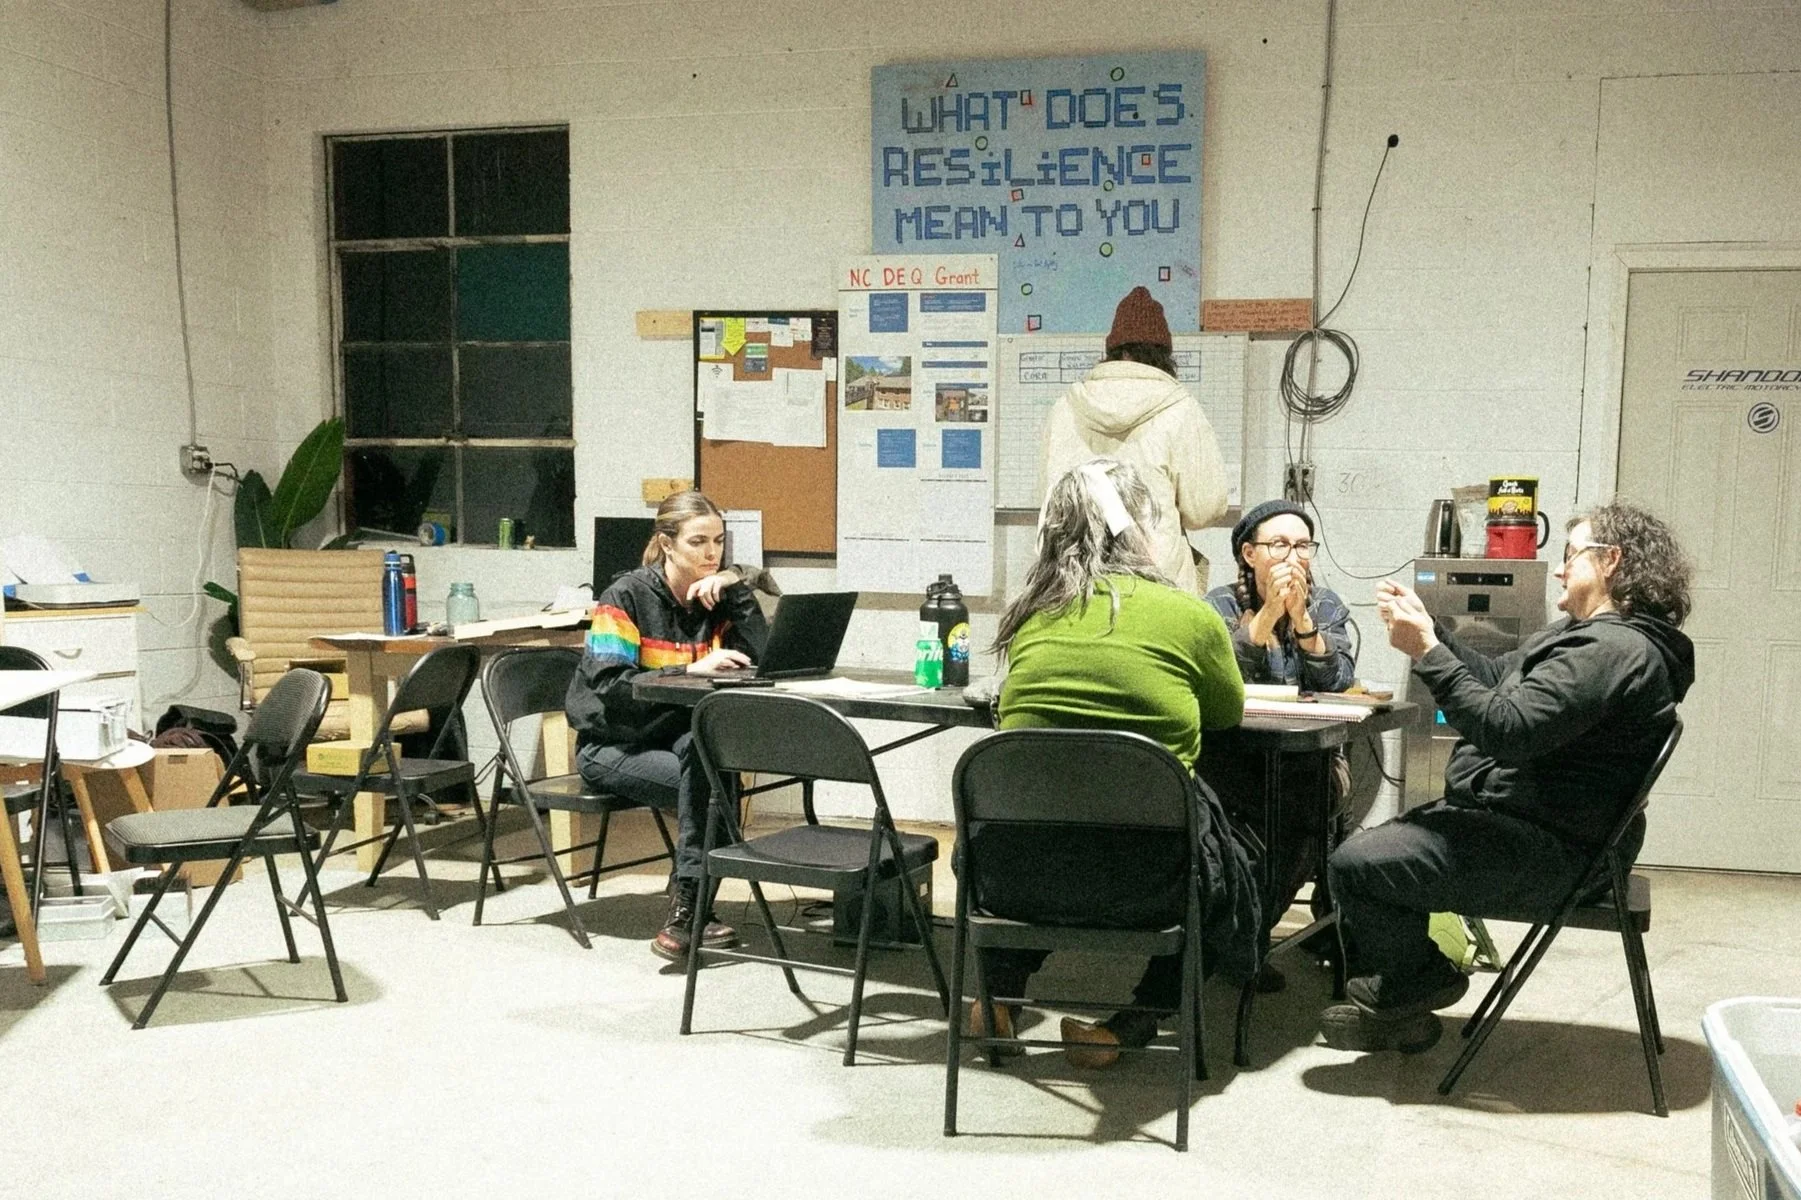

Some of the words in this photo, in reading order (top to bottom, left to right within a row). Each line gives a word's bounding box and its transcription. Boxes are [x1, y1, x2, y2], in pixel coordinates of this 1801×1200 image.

[901, 91, 1018, 133] WHAT
[1046, 84, 1185, 129] DOES
[895, 205, 1007, 244] MEAN
[1022, 203, 1083, 236] TO
[1095, 199, 1180, 236] YOU
[850, 268, 871, 286] NC
[935, 266, 980, 285] Grant
[1683, 369, 1801, 382] SHANDO
[1681, 383, 1740, 391] ELECTRIC
